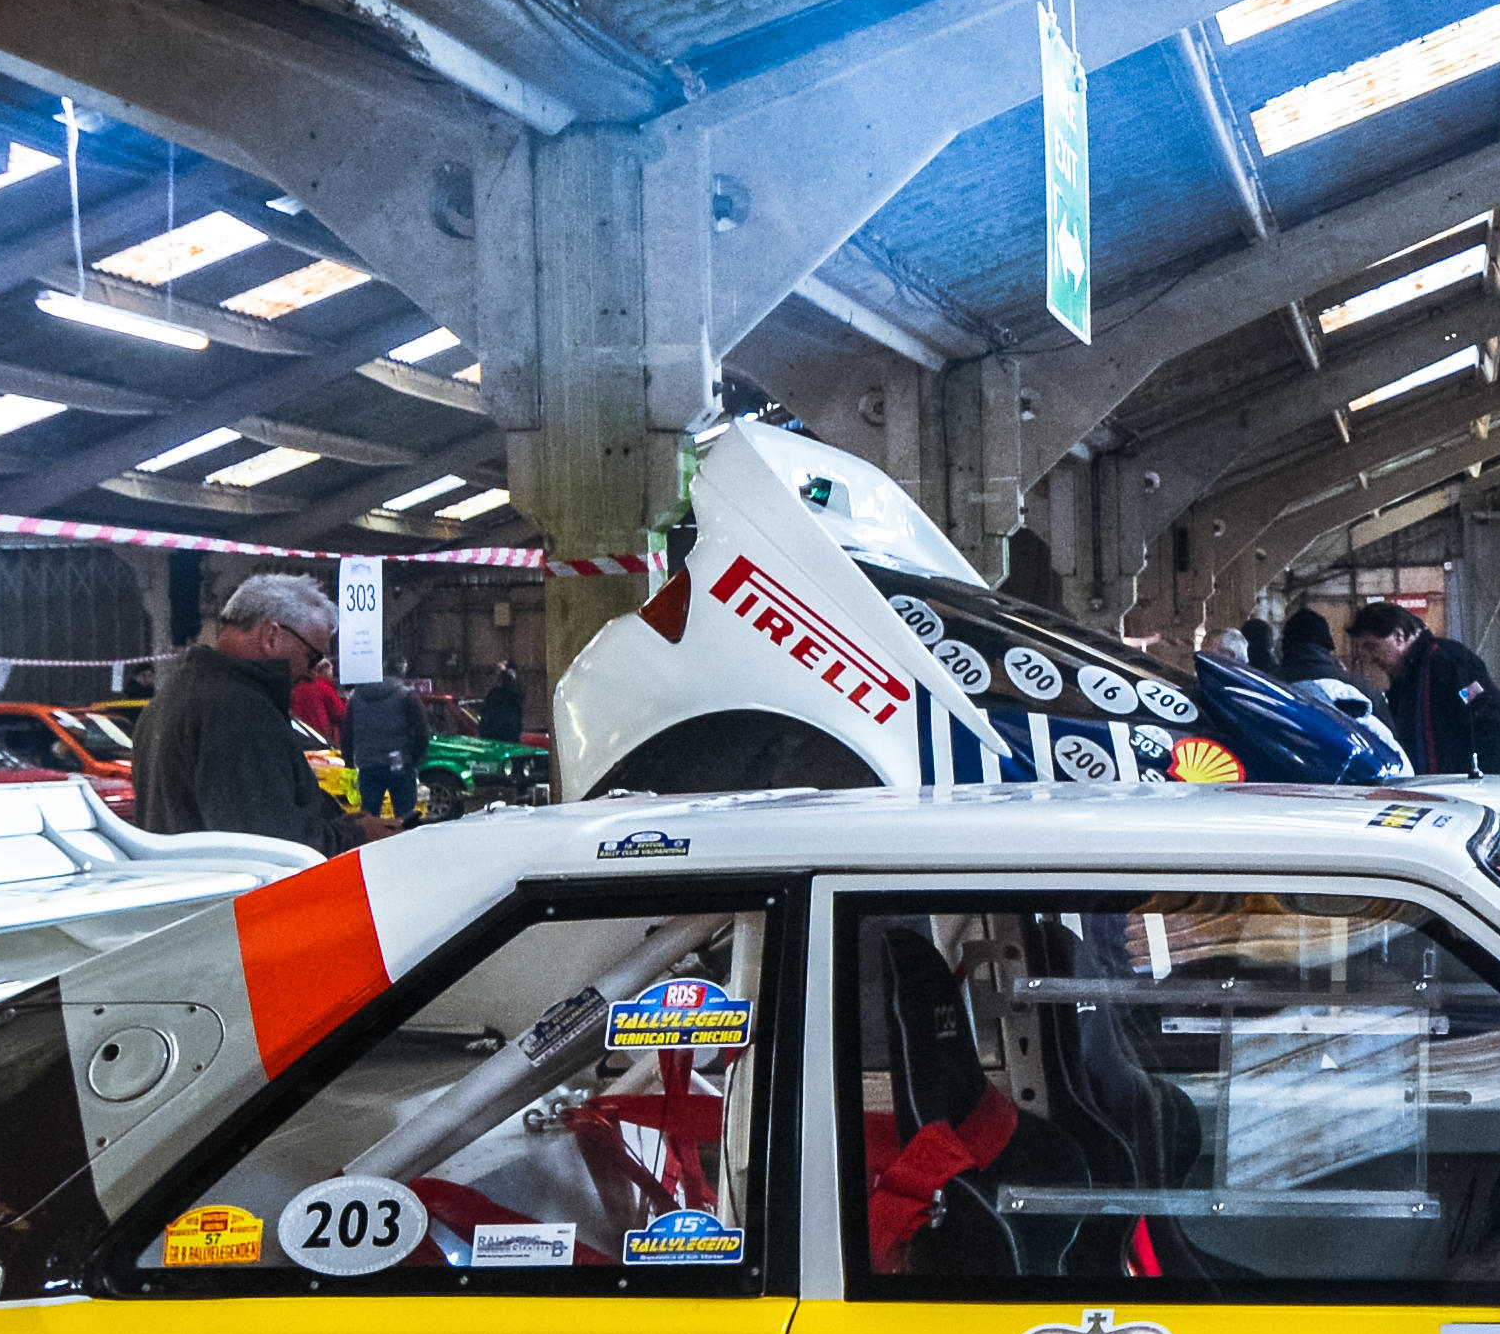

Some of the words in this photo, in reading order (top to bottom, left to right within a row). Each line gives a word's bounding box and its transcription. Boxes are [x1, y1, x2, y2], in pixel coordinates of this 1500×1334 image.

[346, 584, 376, 612] 303
[896, 599, 936, 637] 200
[709, 553, 911, 725] PIRELLI
[940, 646, 982, 686] 200
[1012, 653, 1055, 691] 200
[1092, 676, 1119, 700] 16
[1146, 685, 1189, 716] 200
[1130, 733, 1163, 758] 303
[1062, 741, 1106, 779] 200
[666, 985, 697, 1005] RDS
[614, 1010, 747, 1029] RALLYLEGEND
[614, 1032, 680, 1045] VERIFICATO
[691, 1031, 742, 1043] CHECKED
[302, 1199, 400, 1248] 203
[673, 1217, 707, 1233] 15°
[205, 1233, 221, 1245] 57
[630, 1236, 740, 1253] RALLYLEGEND
